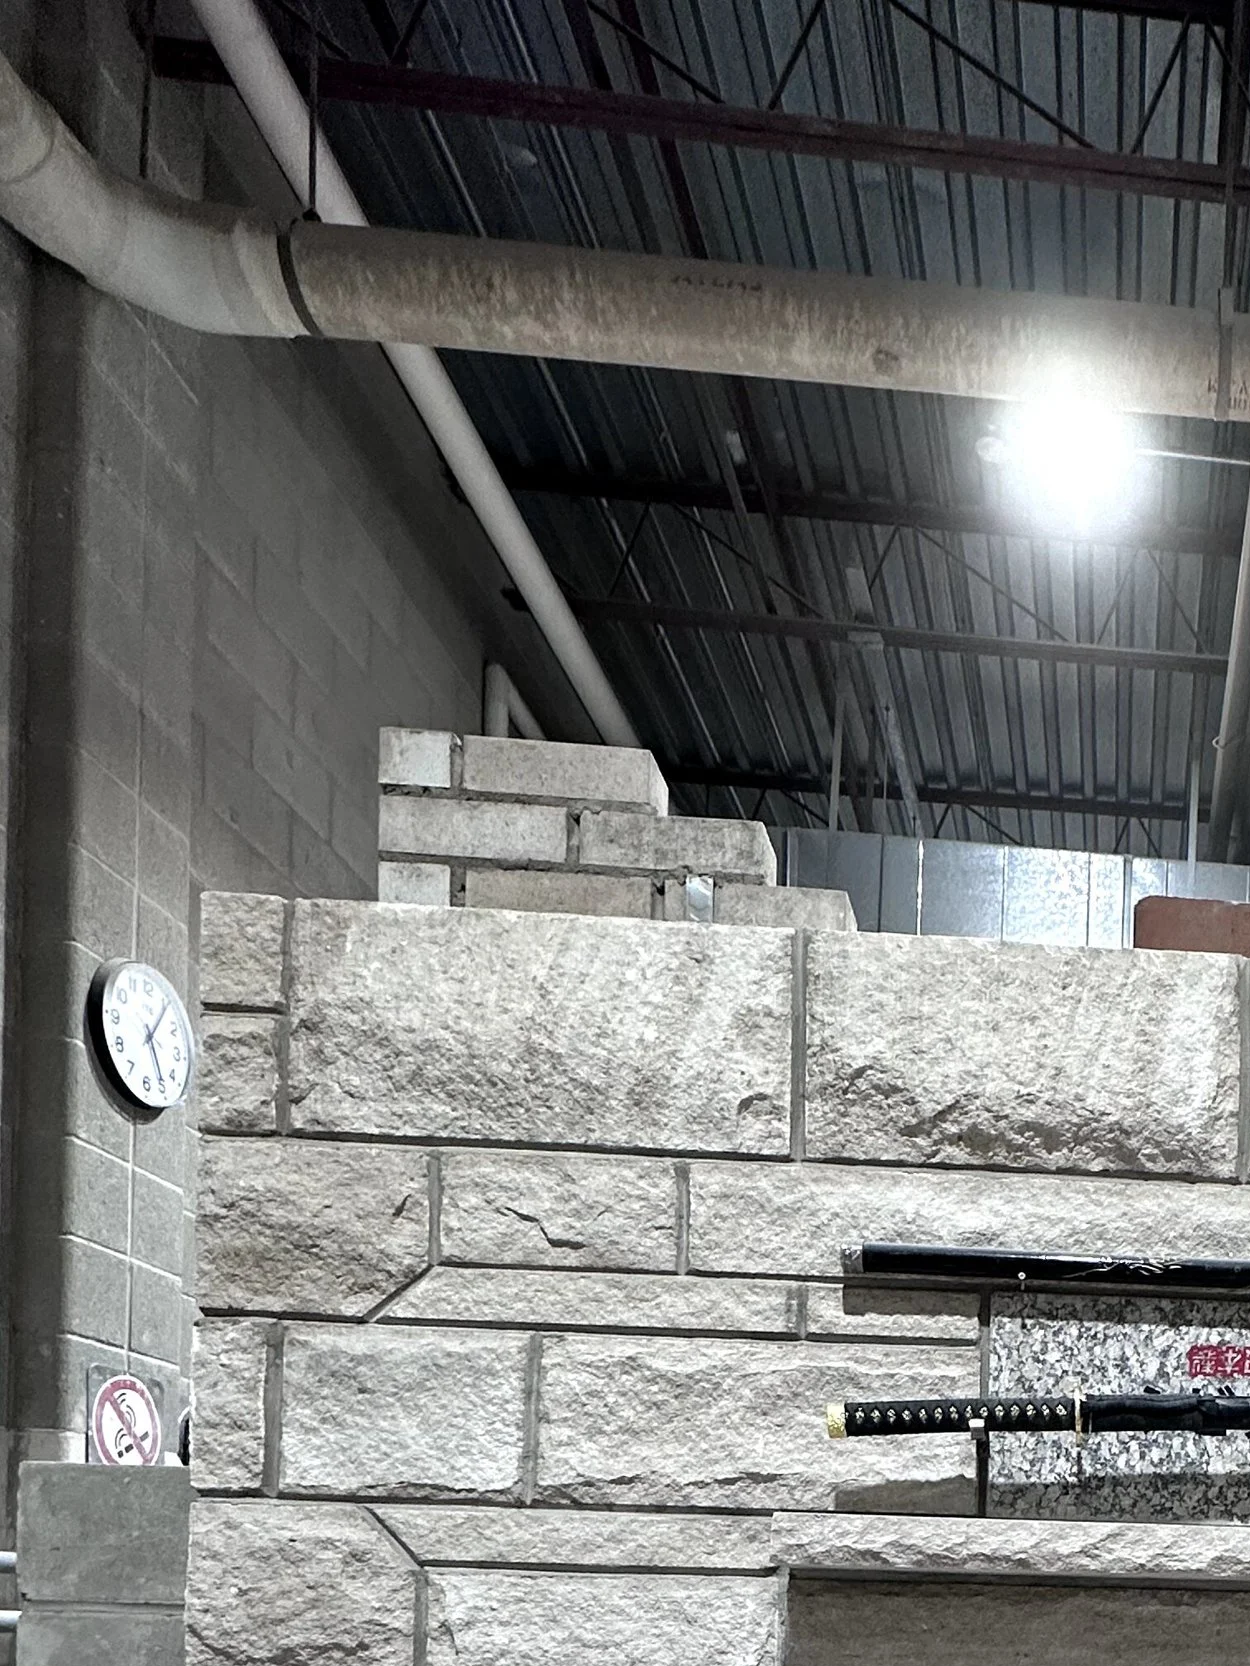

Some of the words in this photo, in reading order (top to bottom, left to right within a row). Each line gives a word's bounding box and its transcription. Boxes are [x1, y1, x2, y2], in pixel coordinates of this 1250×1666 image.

[128, 975, 137, 993] 11
[143, 978, 154, 998] 12
[117, 987, 128, 1004] 10
[110, 1008, 120, 1025] 9
[170, 1021, 178, 1037] 2
[115, 1036, 124, 1053] 8
[172, 1046, 181, 1062] 3
[126, 1059, 135, 1075] 7
[168, 1068, 176, 1083] 4
[142, 1076, 152, 1092] 6
[158, 1078, 167, 1094] 5
